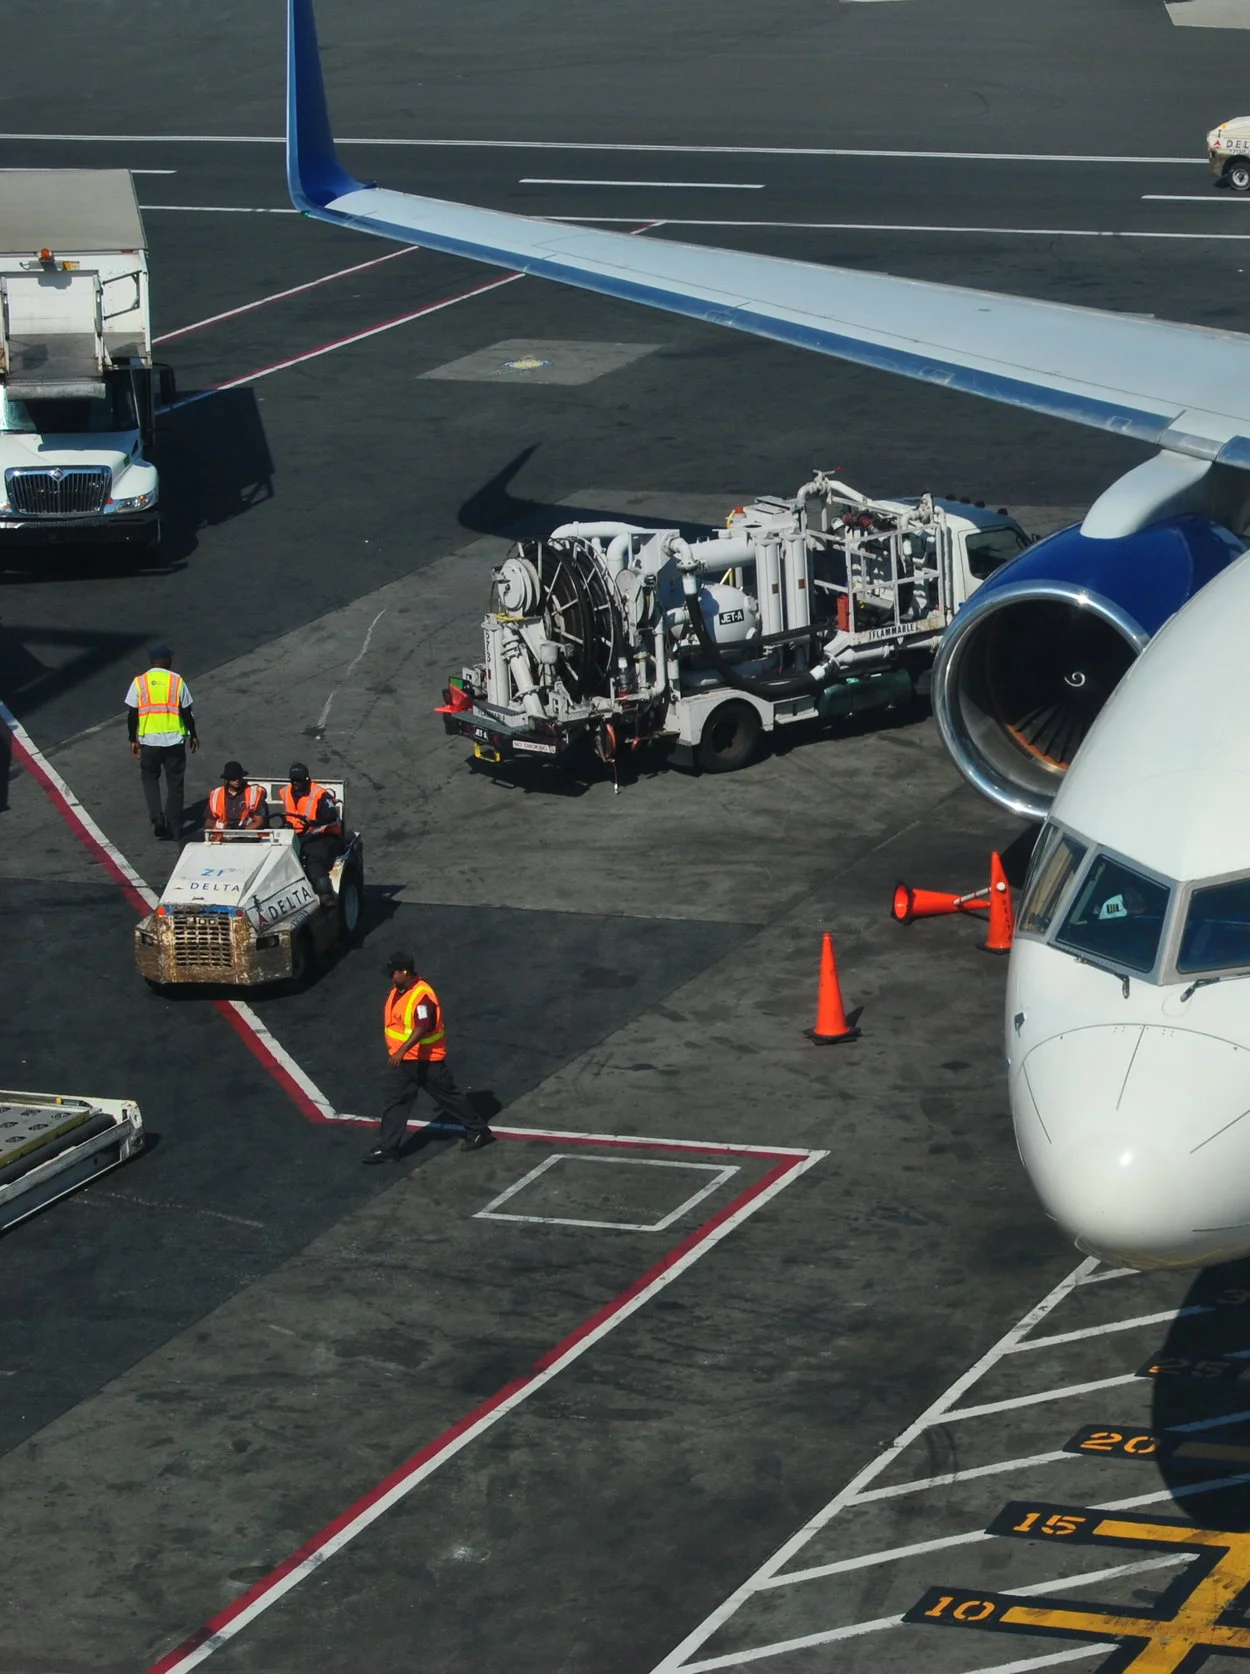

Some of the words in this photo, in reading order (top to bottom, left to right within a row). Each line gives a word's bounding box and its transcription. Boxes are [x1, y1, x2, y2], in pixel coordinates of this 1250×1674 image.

[720, 611, 744, 623] JET-A
[190, 882, 240, 892] DELTA
[270, 886, 312, 920] DELTA
[1148, 1358, 1231, 1379] 25
[1080, 1432, 1160, 1454] 20
[1013, 1512, 1087, 1535] 15
[924, 1596, 996, 1621] 10
